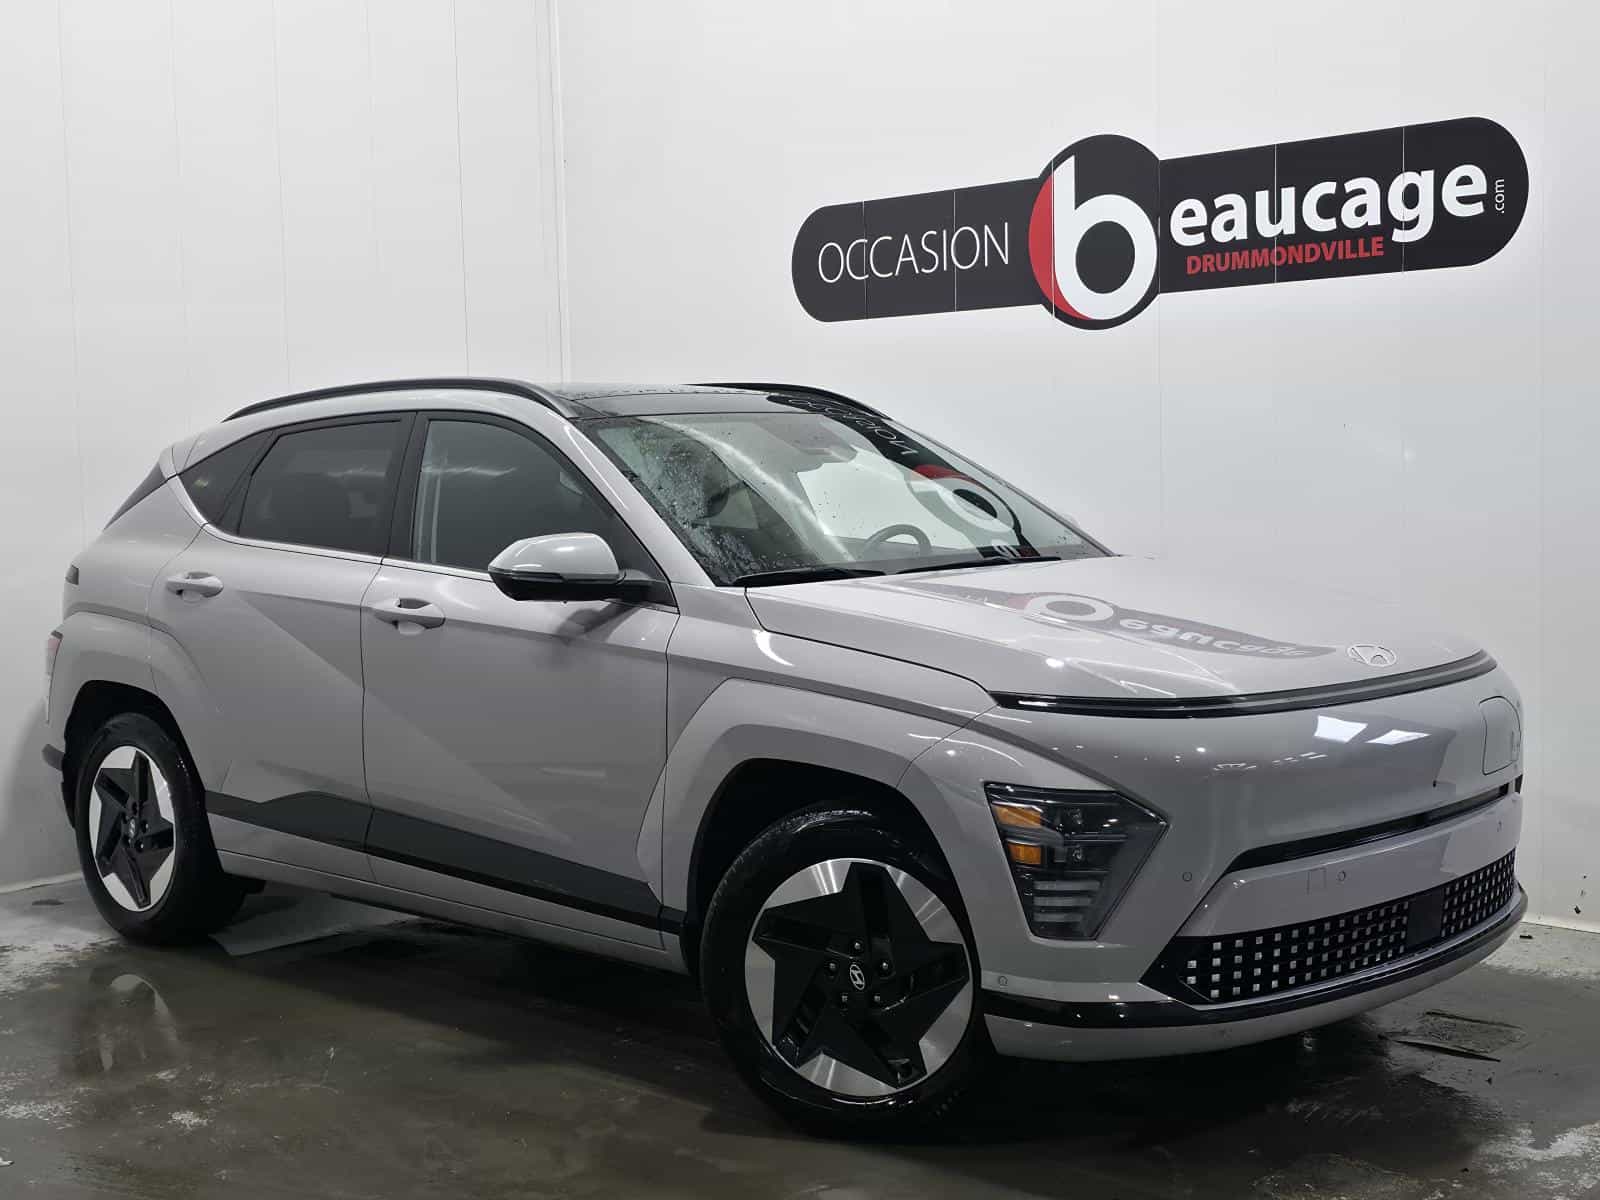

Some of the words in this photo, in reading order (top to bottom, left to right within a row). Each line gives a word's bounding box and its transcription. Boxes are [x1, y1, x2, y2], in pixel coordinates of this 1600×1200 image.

[1495, 178, 1505, 214] .com
[819, 222, 1009, 284] OCCASION
[1186, 236, 1384, 275] DRUMMONDVILLE
